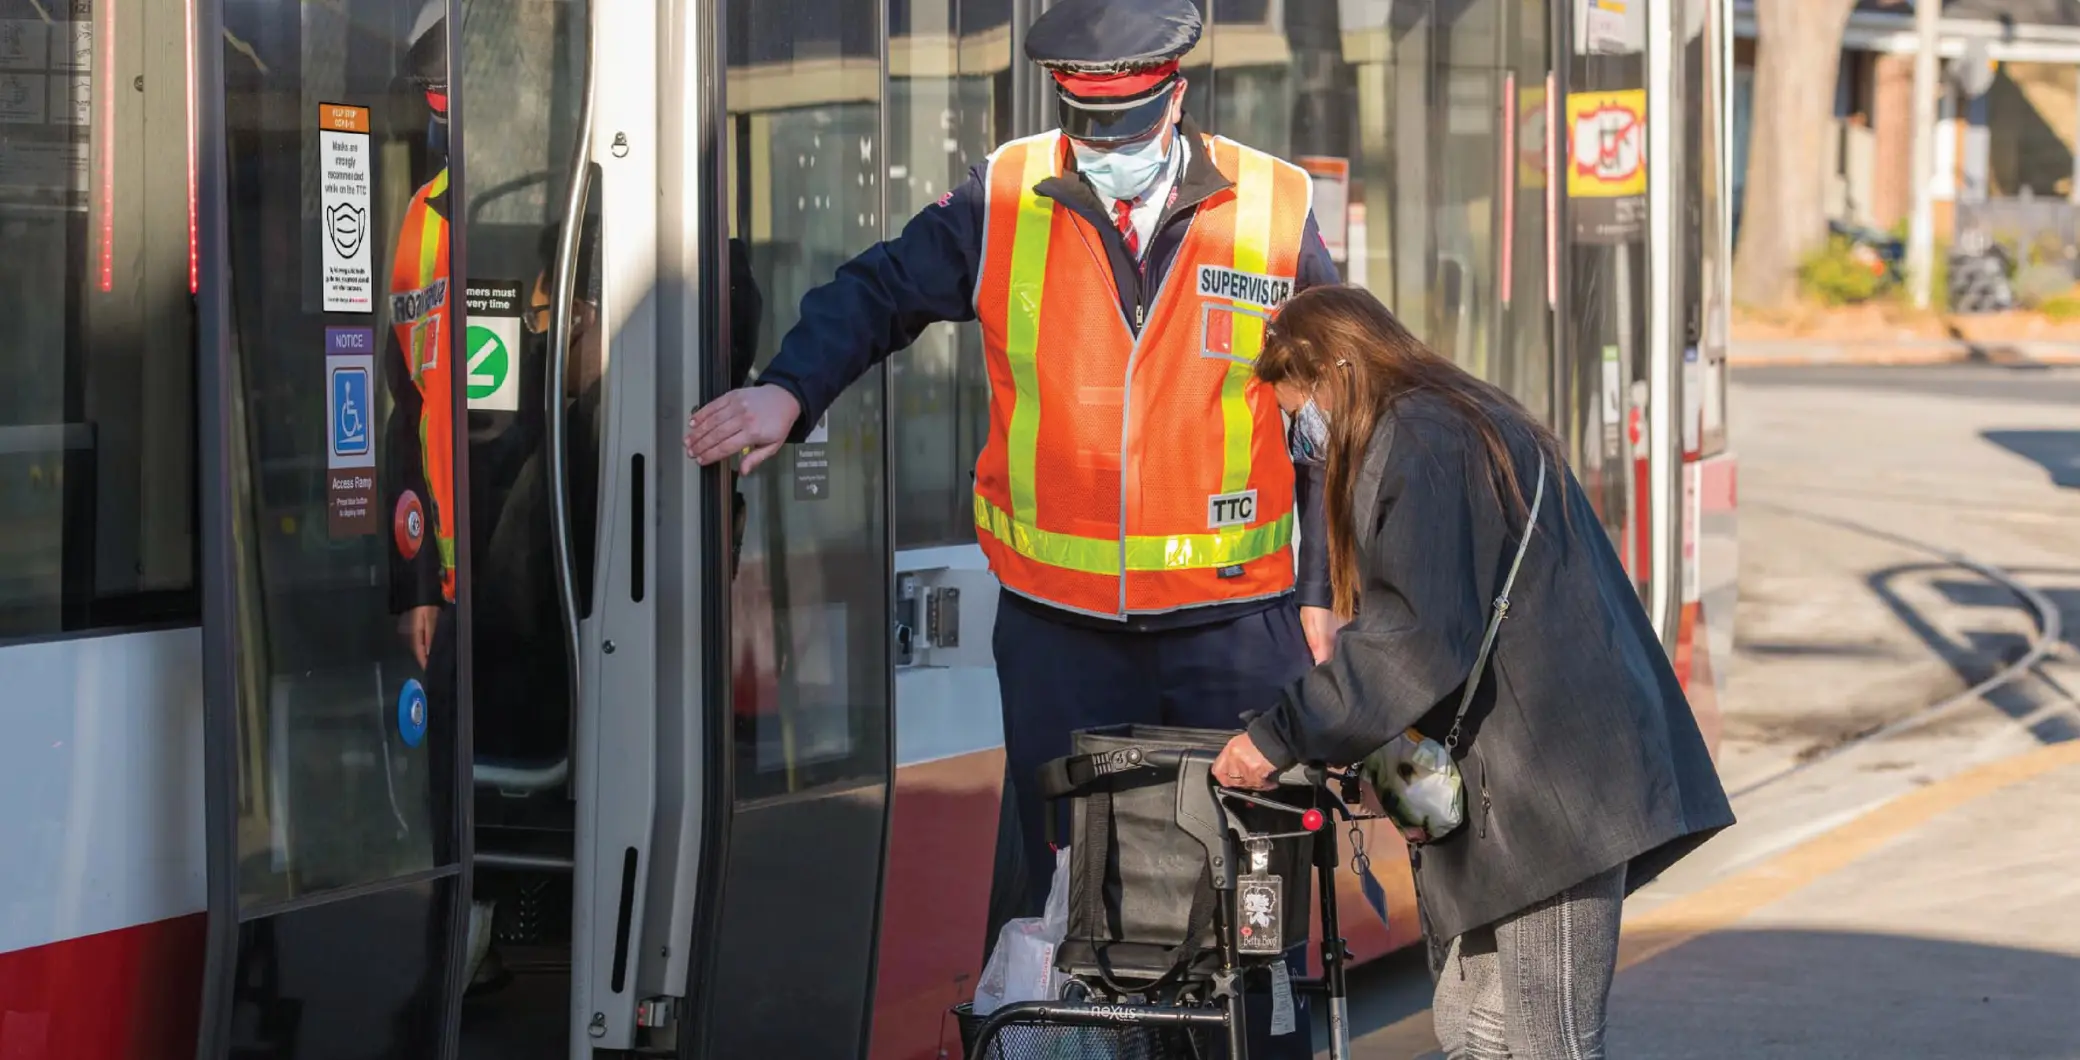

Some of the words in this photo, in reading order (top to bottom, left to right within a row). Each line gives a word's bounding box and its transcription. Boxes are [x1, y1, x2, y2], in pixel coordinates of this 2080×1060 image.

[492, 288, 516, 298] must
[1201, 268, 1290, 306] SUPERVISOR
[489, 299, 510, 309] time
[335, 334, 363, 348] NOTICE
[332, 477, 354, 490] Access
[354, 476, 372, 490] Ramp
[1213, 496, 1252, 522] TTC
[1243, 935, 1261, 949] Betty
